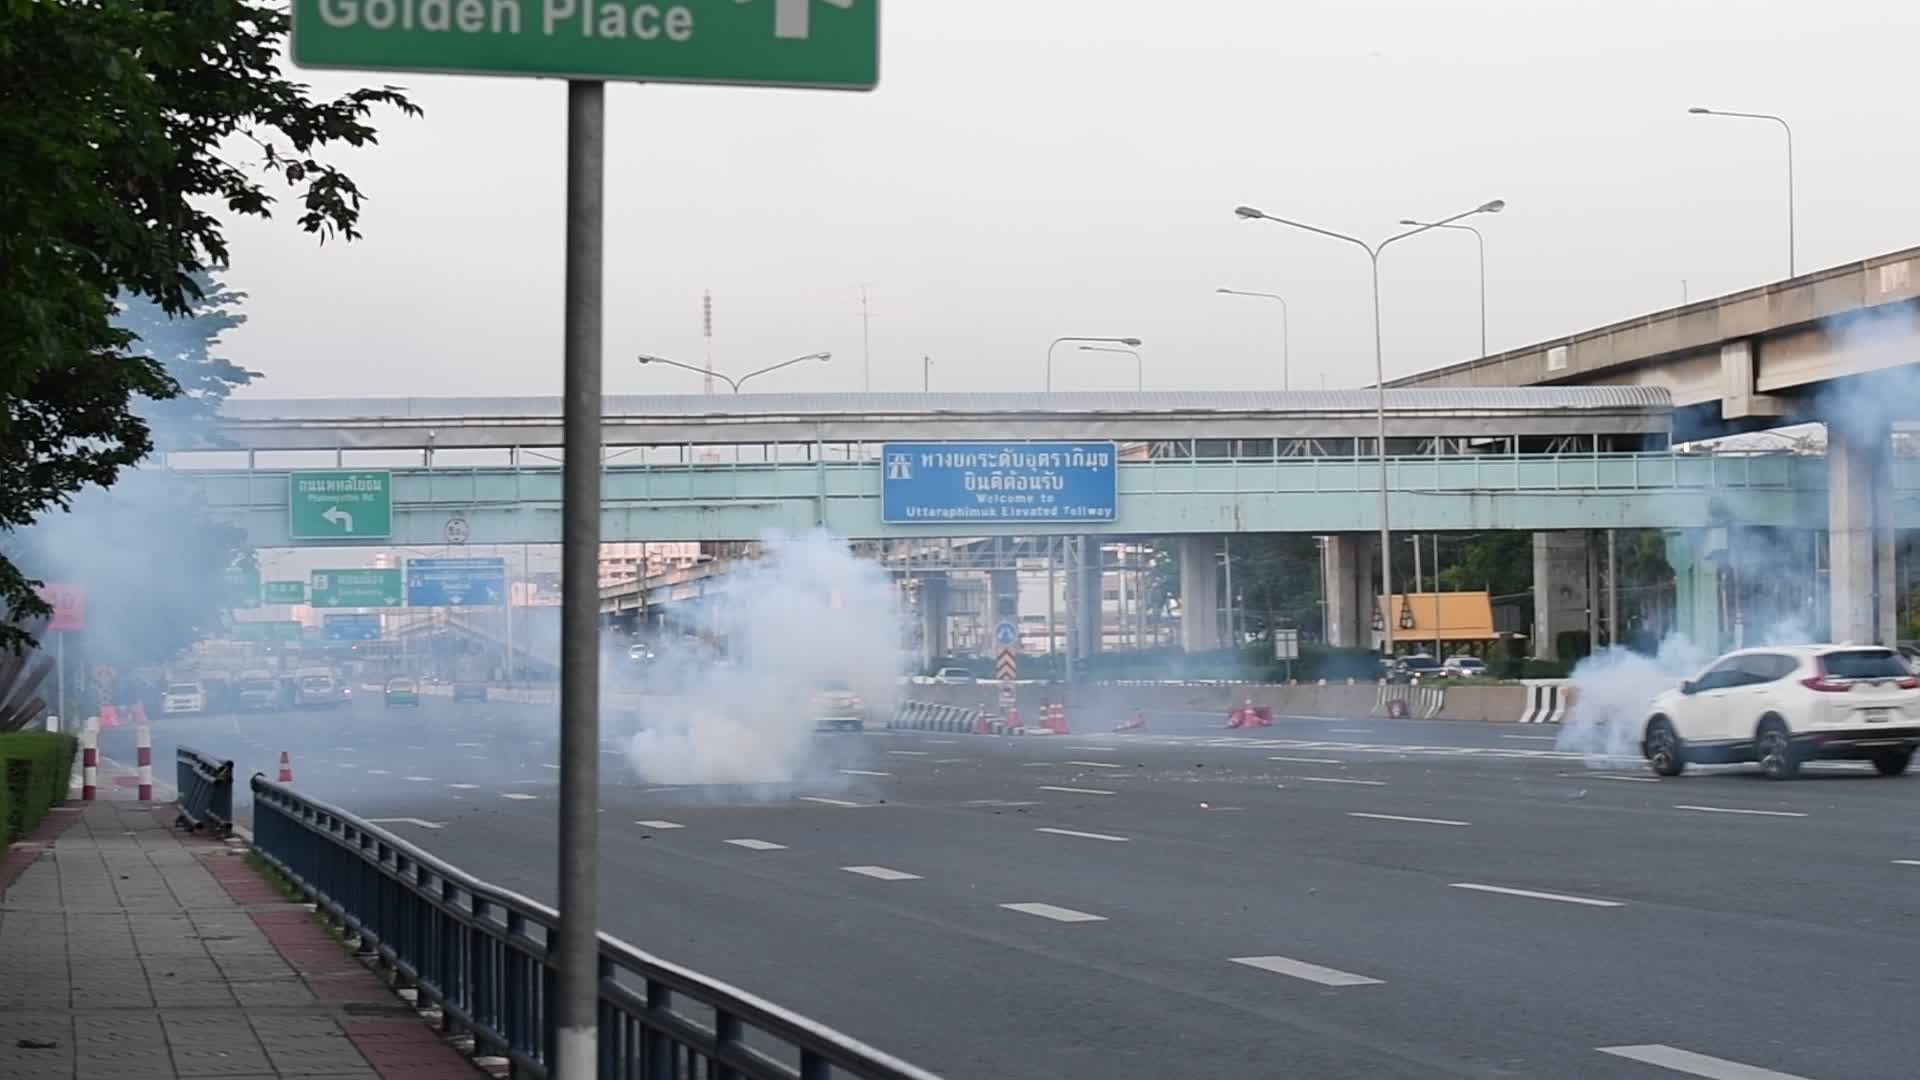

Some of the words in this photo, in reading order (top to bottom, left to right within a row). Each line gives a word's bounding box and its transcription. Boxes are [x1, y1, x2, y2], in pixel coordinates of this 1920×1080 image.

[318, 0, 521, 34] Golden
[543, 0, 694, 41] Place
[964, 471, 1064, 491] ยินดีต้อนรับ
[976, 494, 1034, 504] Welcome
[1041, 494, 1055, 503] to
[1001, 506, 1058, 517] Elevated
[1064, 505, 1113, 518] Tollway
